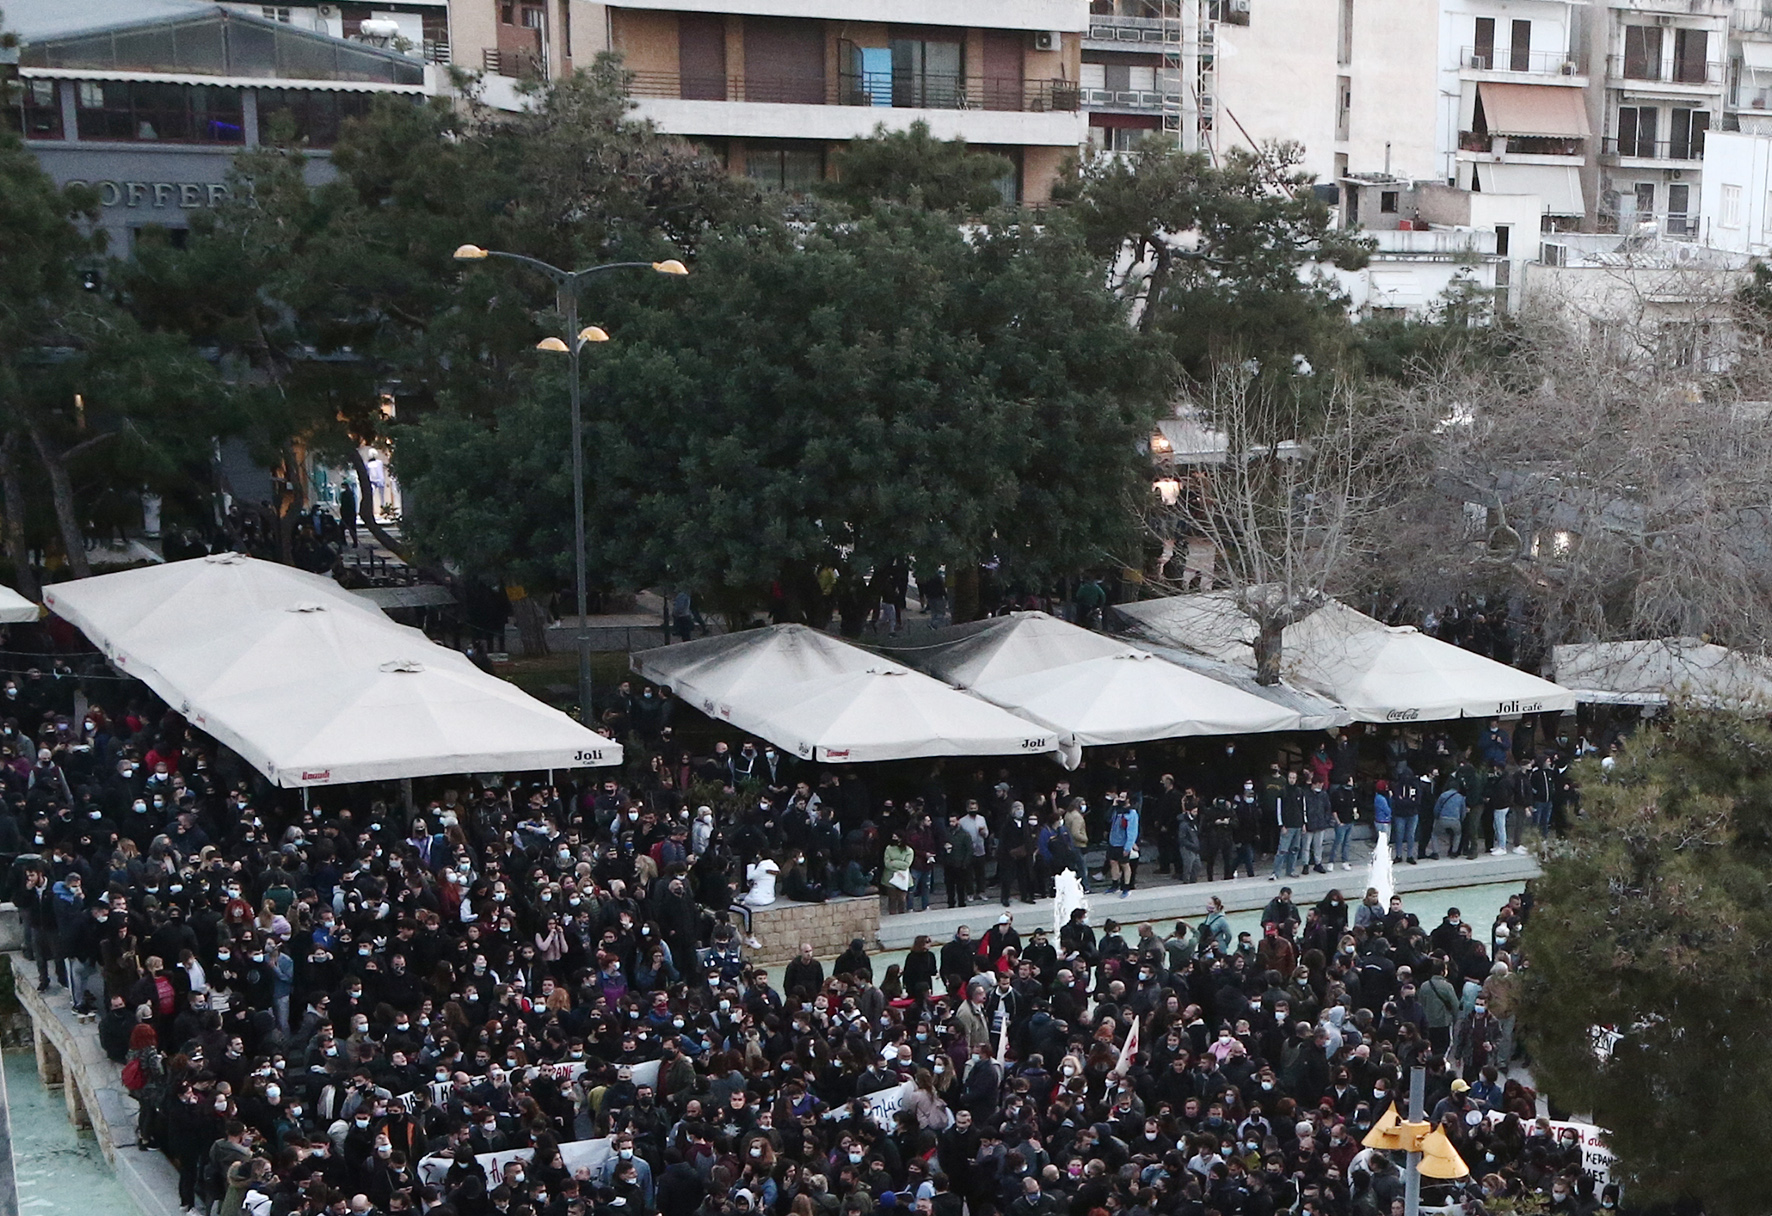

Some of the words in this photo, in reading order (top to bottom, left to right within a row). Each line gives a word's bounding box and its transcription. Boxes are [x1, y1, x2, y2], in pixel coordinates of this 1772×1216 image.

[1495, 701, 1519, 714] Joli
[1021, 739, 1046, 748] Joli
[574, 750, 603, 761] Joli
